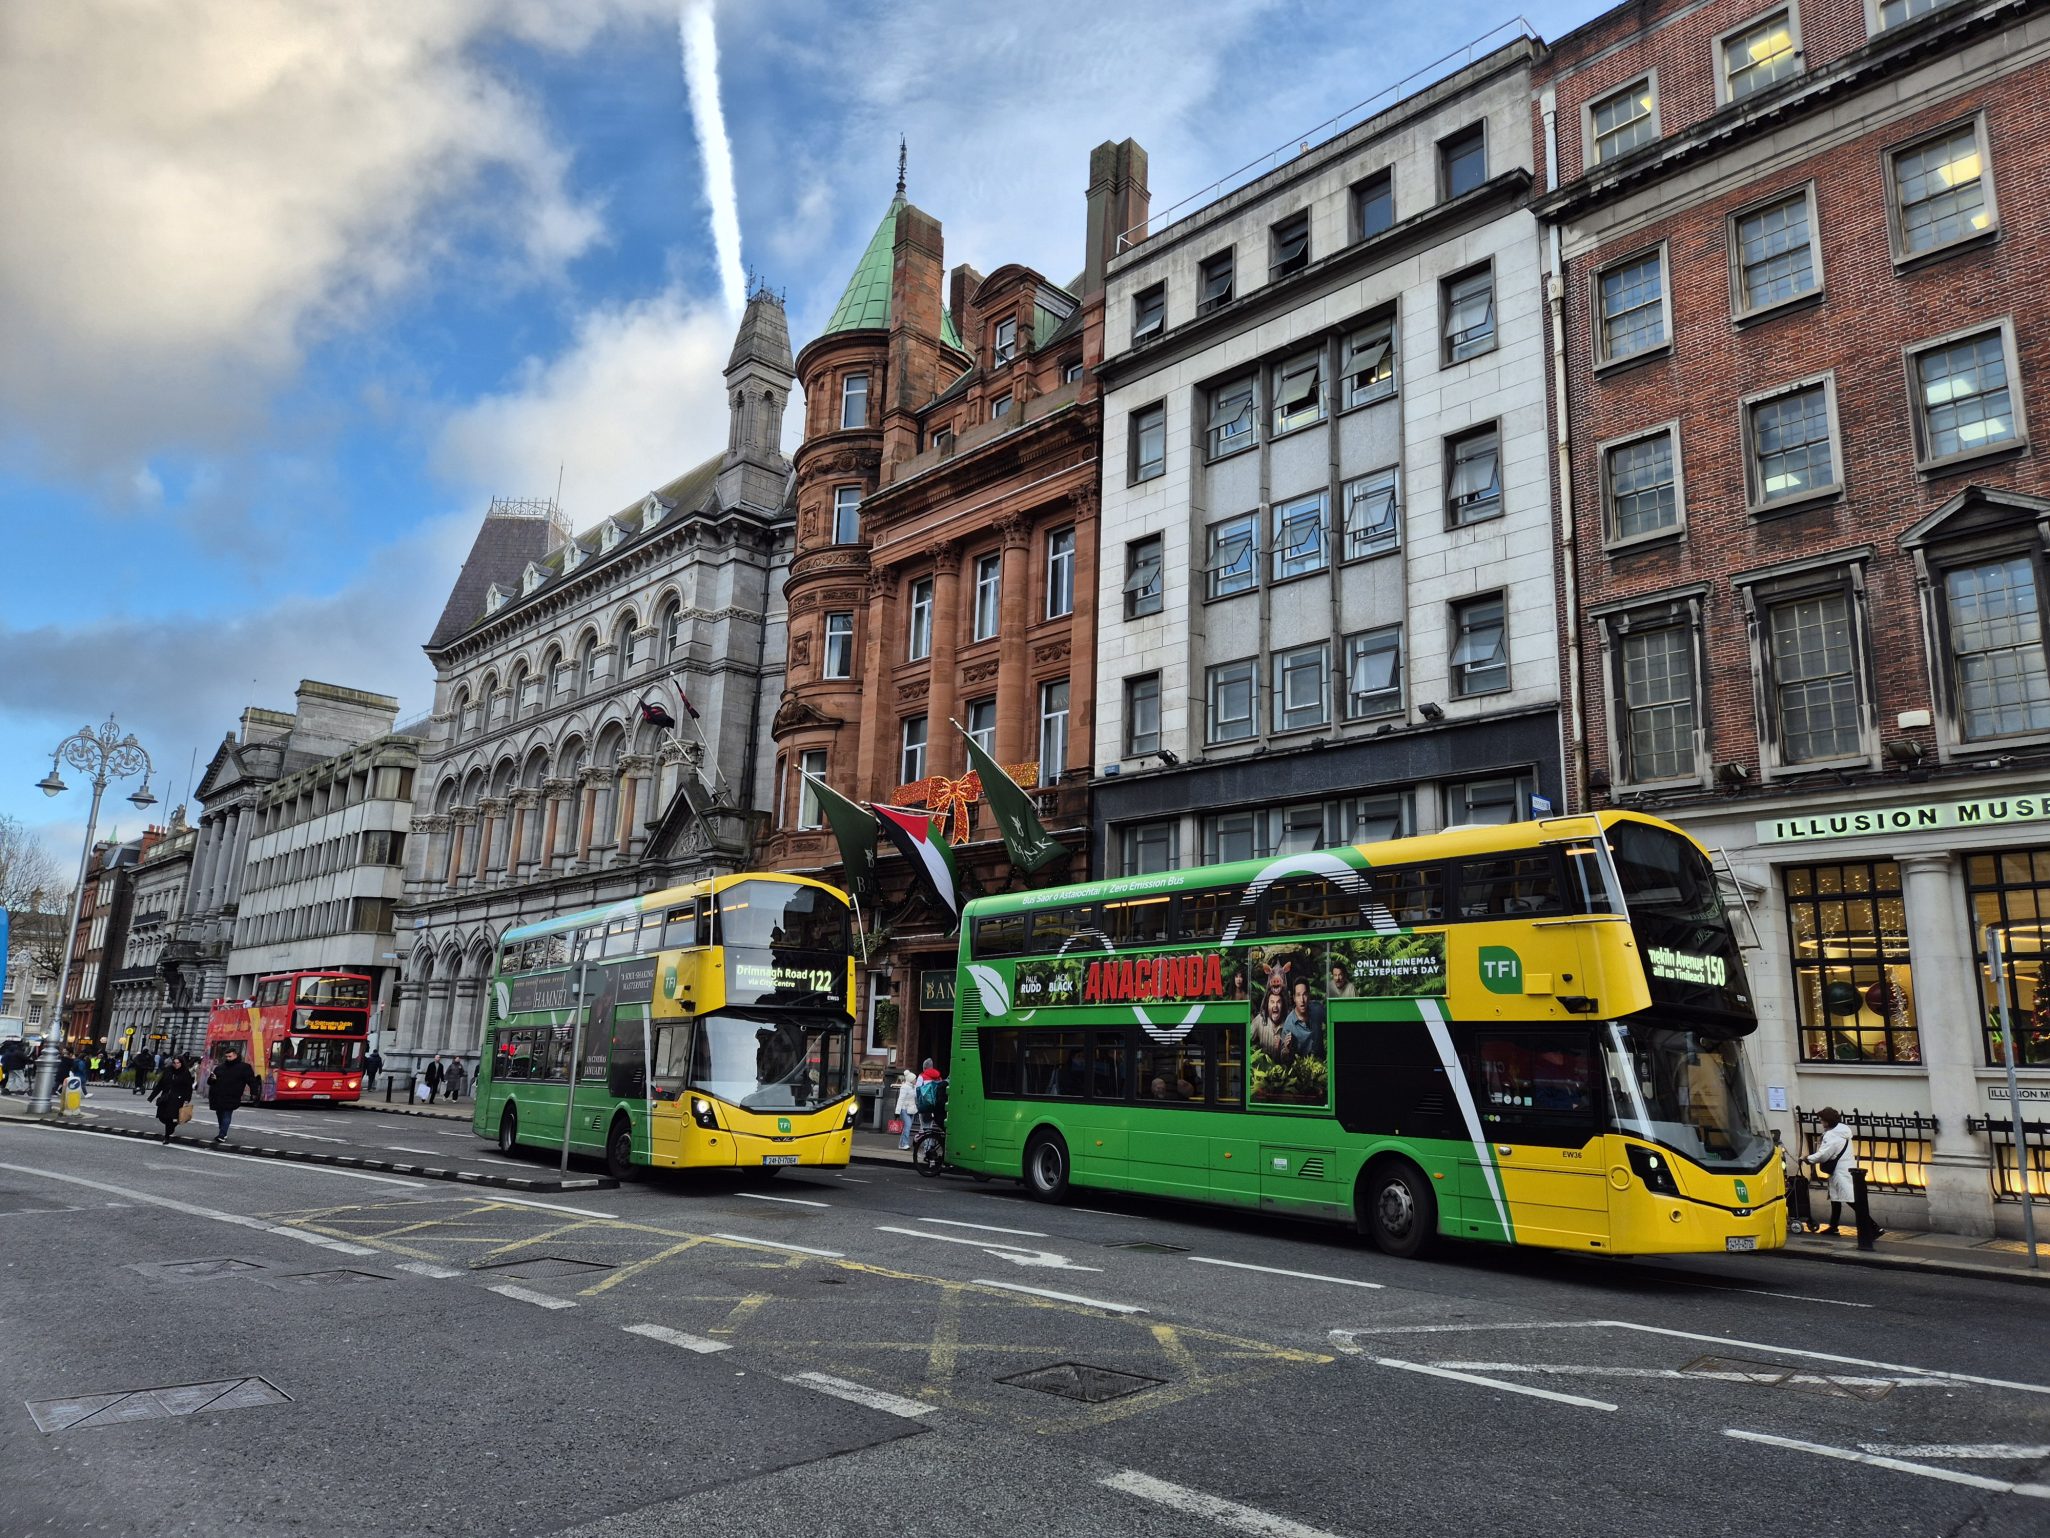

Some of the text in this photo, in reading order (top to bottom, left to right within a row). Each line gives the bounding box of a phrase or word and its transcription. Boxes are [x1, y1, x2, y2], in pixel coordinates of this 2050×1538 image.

[1776, 808, 1937, 838] ILLUSION
[1022, 896, 1035, 905] Bus
[1109, 883, 1128, 894] Zero
[1129, 879, 1166, 891] Emission
[1167, 876, 1184, 886] Bus
[1356, 957, 1436, 968] ONLY IN CINEMAS
[1676, 951, 1705, 971] Avenue
[736, 965, 808, 980] Drimnagh Road
[1353, 966, 1440, 977] ST. STEPHEN'S DAY
[1483, 960, 1517, 978] TFI
[1704, 955, 1726, 986] 150
[665, 976, 676, 989] TFI
[760, 978, 773, 987] City
[774, 980, 796, 988] Centre
[808, 969, 832, 992] 122
[1026, 975, 1038, 984] PAUL
[1055, 974, 1068, 982] JACK
[1084, 954, 1223, 1000] ANACONDA
[1021, 984, 1042, 994] RUDD
[1049, 981, 1073, 993] BLACK
[1991, 1089, 2038, 1099] ILLUION
[1562, 1150, 1582, 1159] EW36
[1736, 1186, 1747, 1196] TFI
